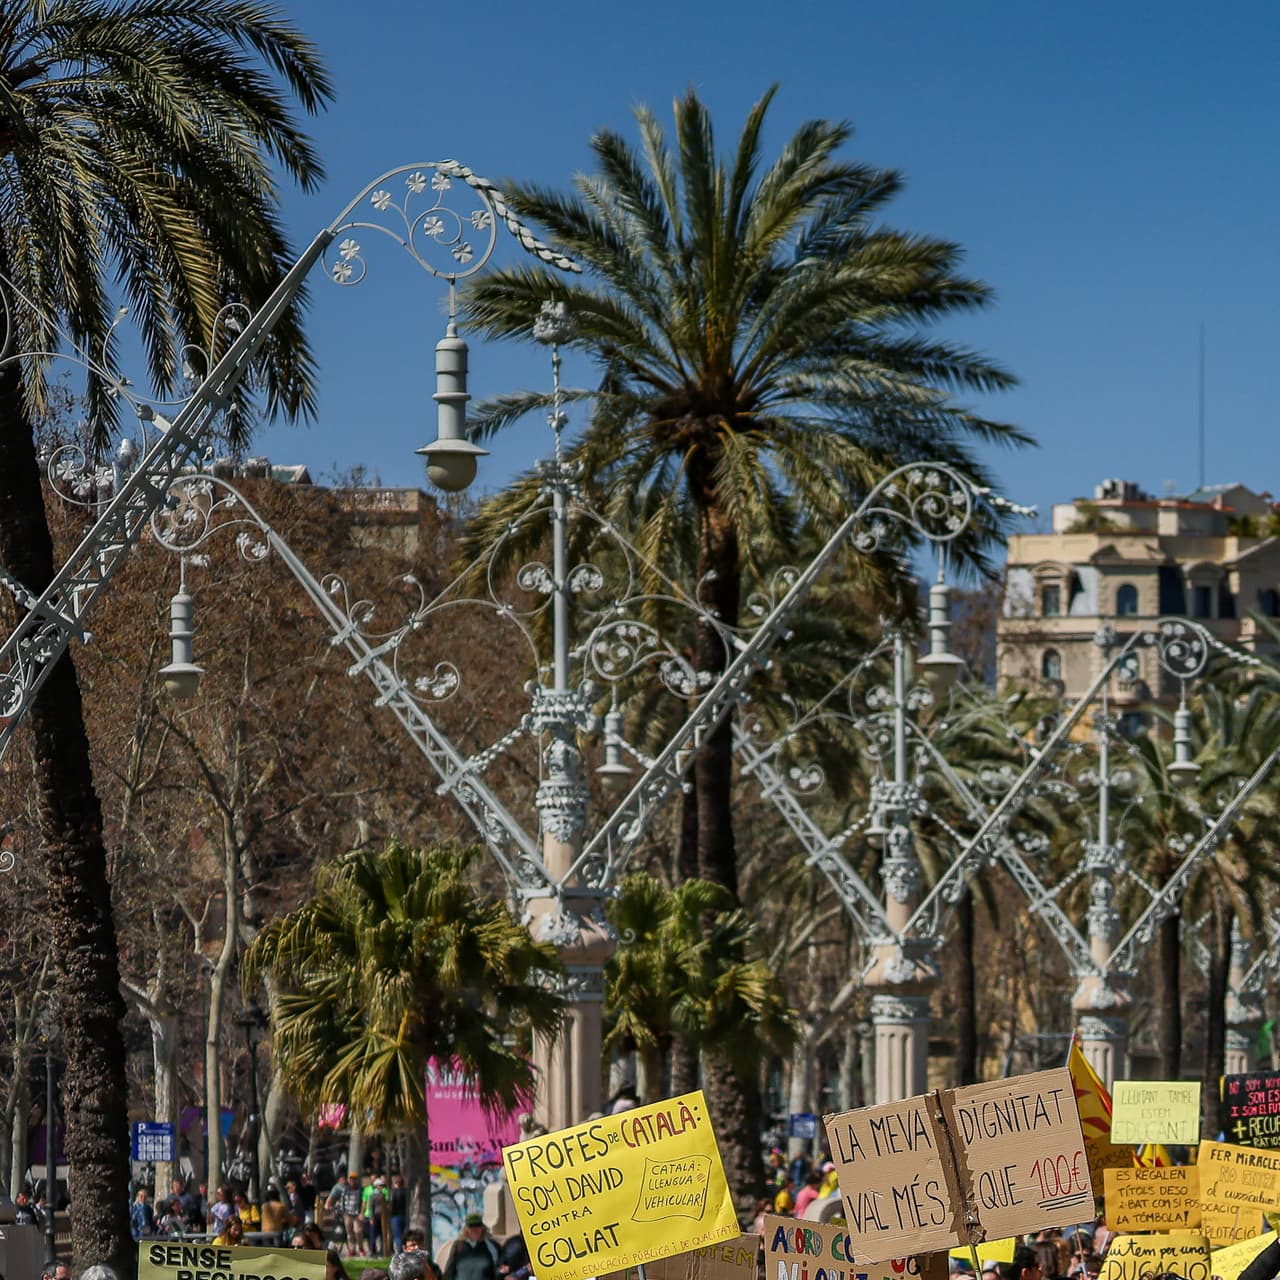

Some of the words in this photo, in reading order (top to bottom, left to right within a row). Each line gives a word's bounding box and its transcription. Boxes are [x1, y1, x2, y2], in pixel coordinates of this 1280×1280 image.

[835, 1124, 866, 1164] LA
[870, 1109, 932, 1156] MEVA
[508, 1125, 608, 1182] PROFES
[1210, 1149, 1231, 1161] FER
[649, 1175, 693, 1191] LLENGUA
[1116, 1170, 1130, 1181] ES
[1136, 1169, 1186, 1181] REGALEN
[517, 1181, 562, 1217] SOM
[565, 1168, 623, 1201] DAVID
[846, 1190, 889, 1233] VAL
[892, 1173, 946, 1230] MÉS
[979, 1165, 1024, 1210] QUE
[1030, 1151, 1087, 1200] 100€
[1152, 1199, 1170, 1209] COM
[530, 1206, 592, 1236] CONTRA
[1116, 1216, 1129, 1225] LA
[771, 1226, 823, 1257] ACORD
[1160, 1248, 1178, 1259] per
[150, 1244, 232, 1271] SENSE
